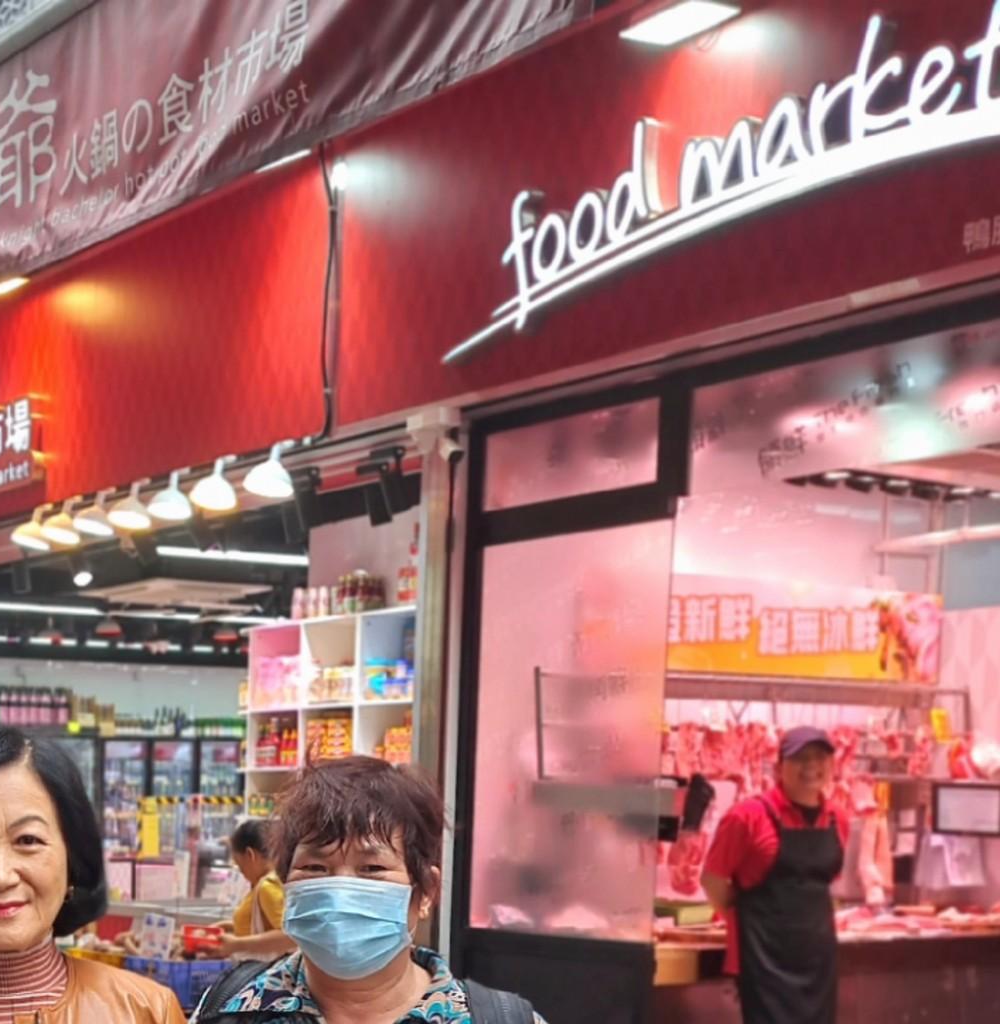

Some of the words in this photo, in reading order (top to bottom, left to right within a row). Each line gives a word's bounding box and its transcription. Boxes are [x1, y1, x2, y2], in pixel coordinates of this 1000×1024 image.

[229, 79, 310, 135] market
[502, 117, 652, 330] food
[679, 0, 1000, 206] market
